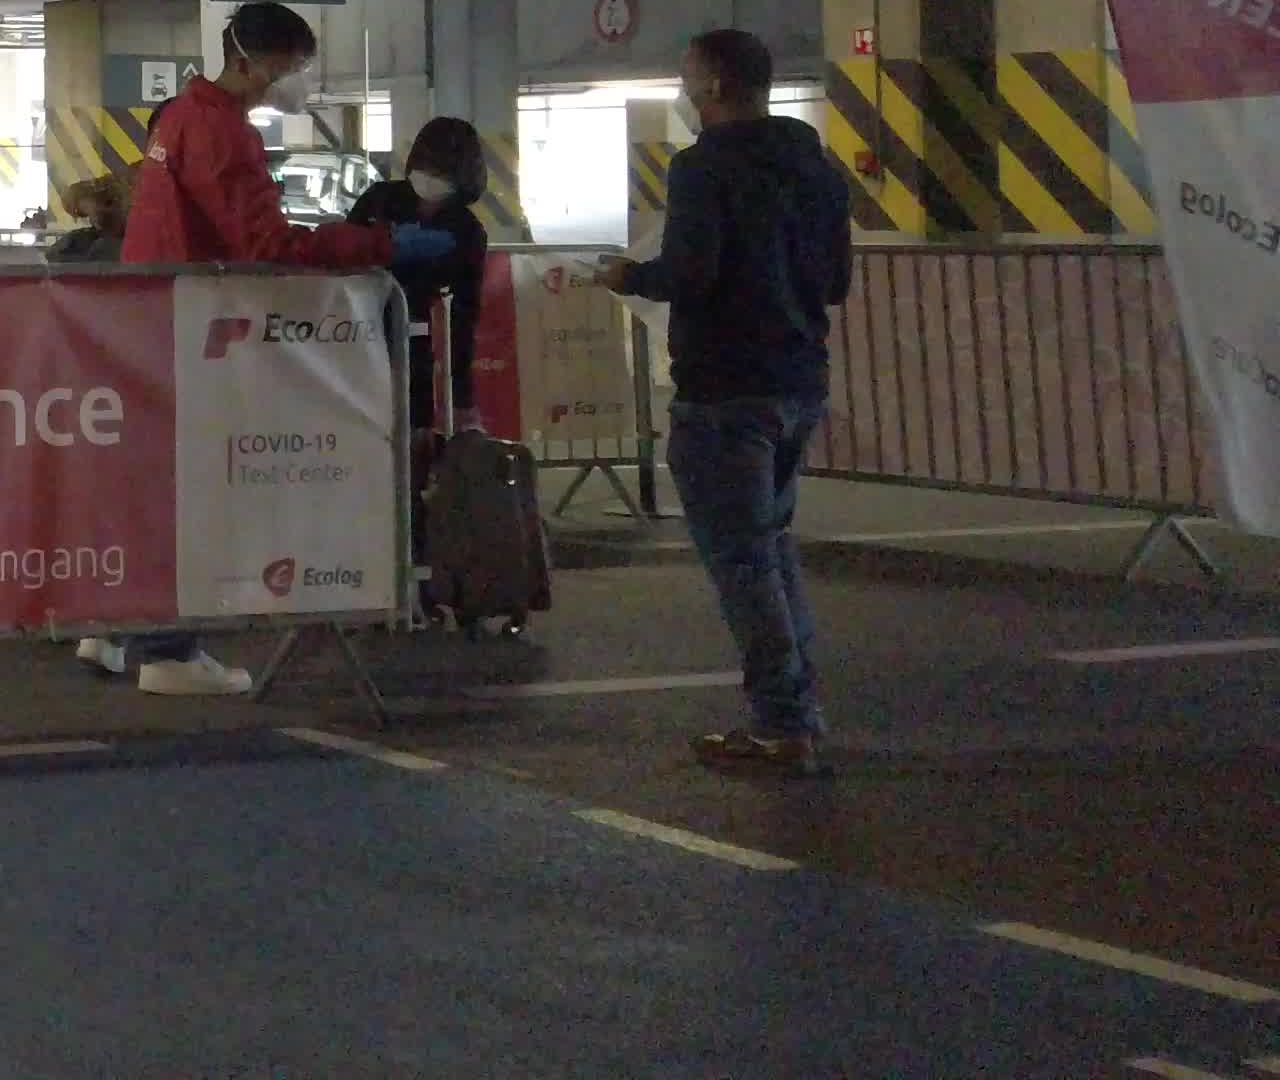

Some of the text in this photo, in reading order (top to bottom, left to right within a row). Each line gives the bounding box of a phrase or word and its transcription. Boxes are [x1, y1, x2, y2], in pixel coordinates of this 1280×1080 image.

[237, 433, 338, 455] COVID-19
[239, 464, 353, 486] Test Center
[303, 567, 364, 589] Ecolog
